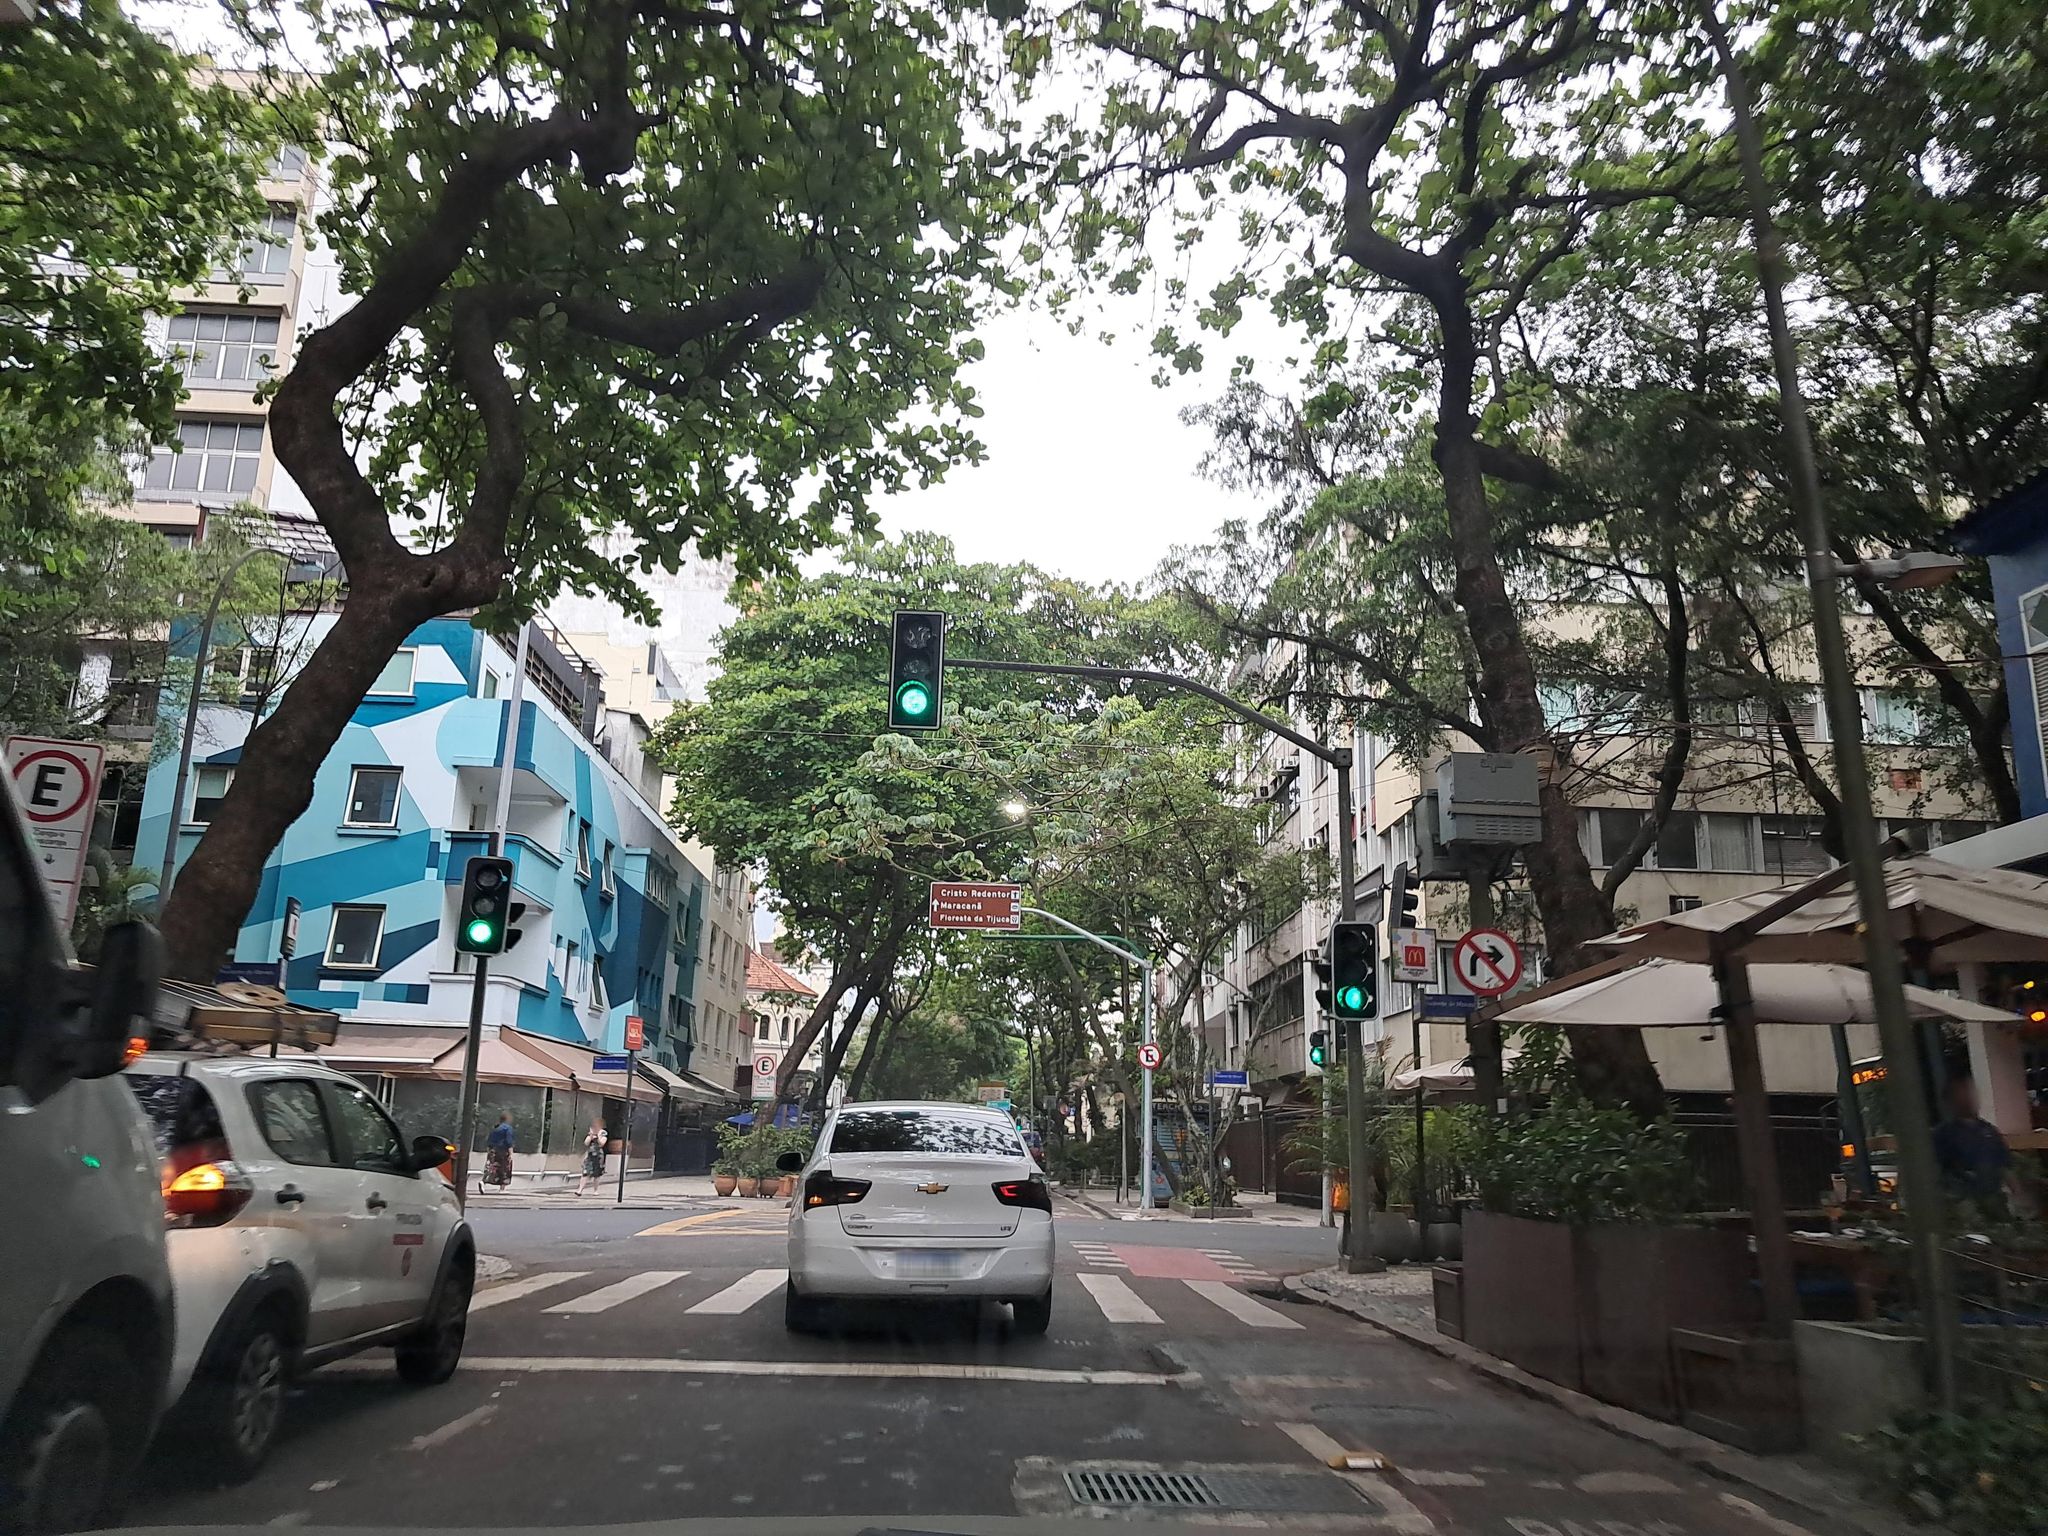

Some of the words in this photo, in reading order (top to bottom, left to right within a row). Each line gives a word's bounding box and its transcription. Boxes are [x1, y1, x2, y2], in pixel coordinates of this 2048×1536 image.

[31, 764, 66, 807] E
[941, 889, 968, 897] Cristo
[971, 890, 1010, 899] Redentor
[940, 901, 982, 910] Maracanã
[940, 914, 971, 922] Floresta
[974, 915, 983, 923] da
[986, 915, 1010, 924] Tijuca
[1145, 1049, 1154, 1062] E
[761, 1060, 769, 1071] E
